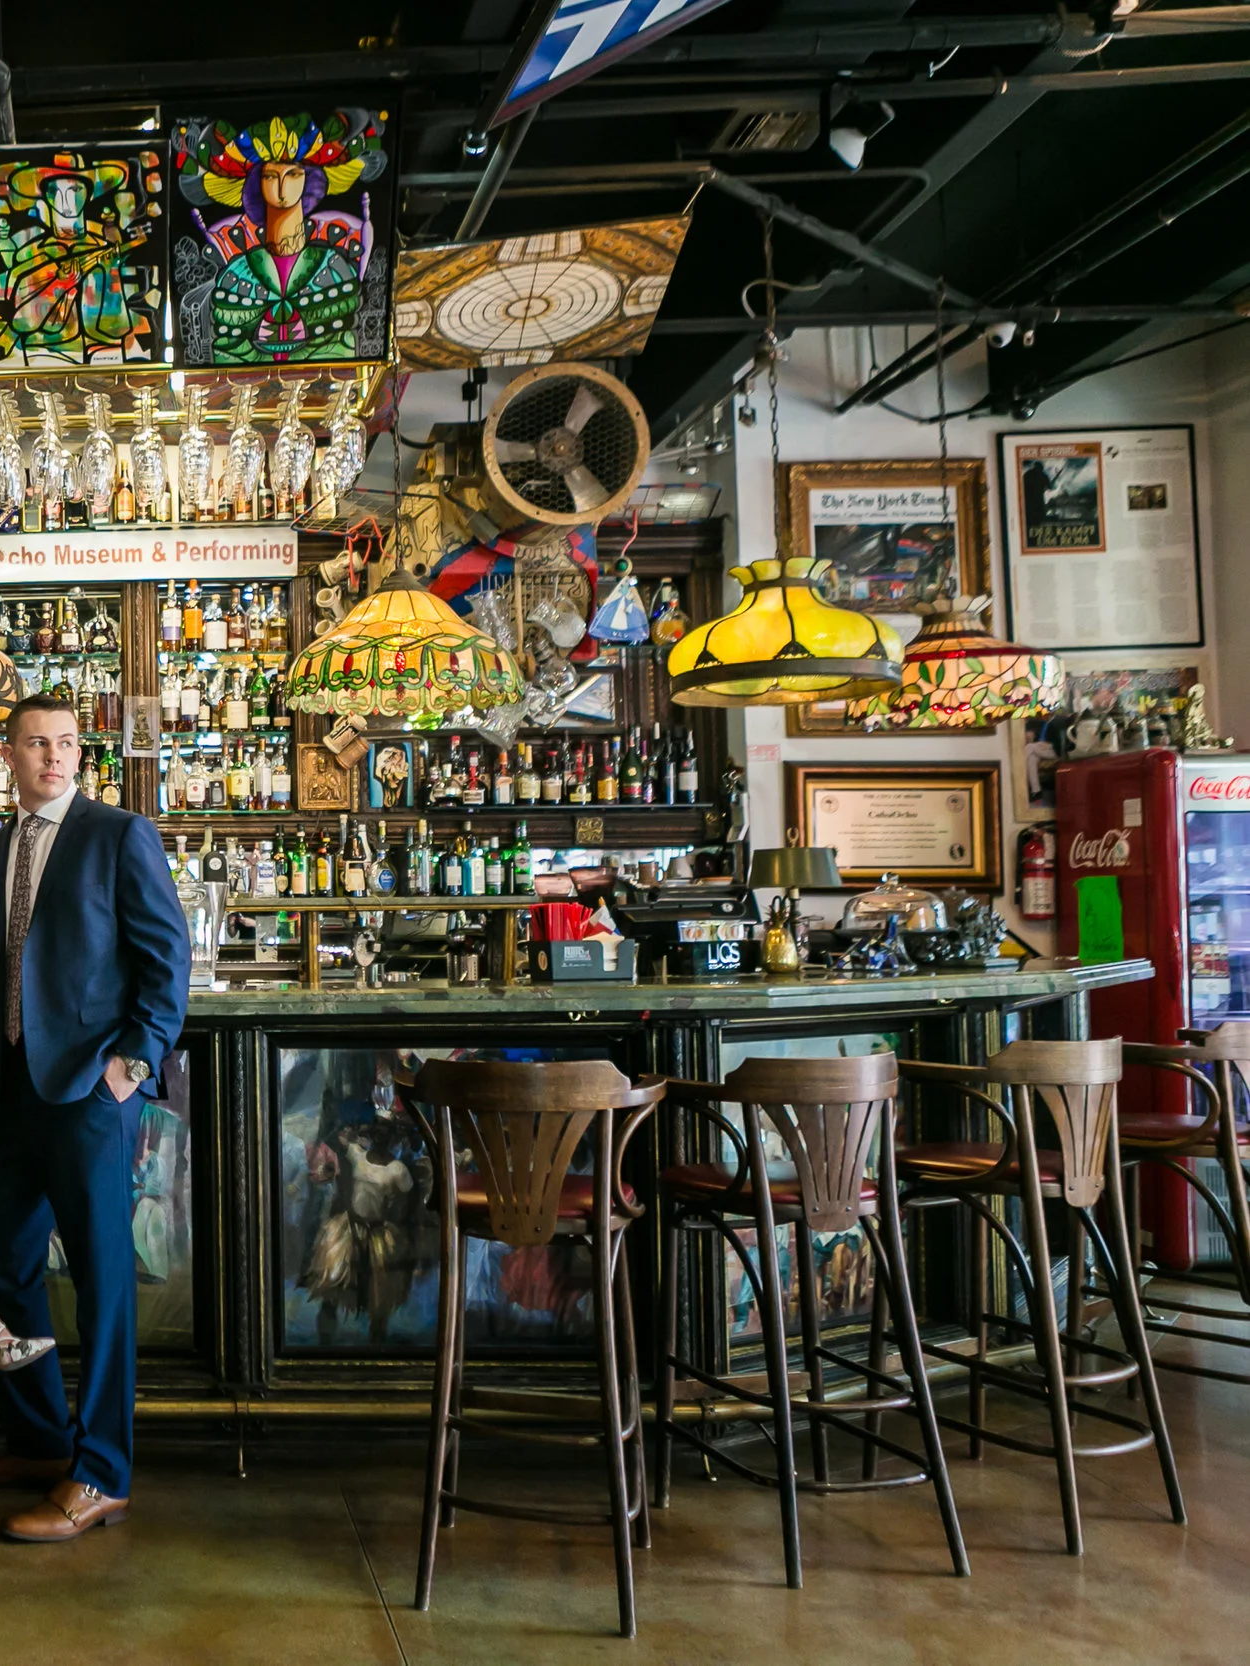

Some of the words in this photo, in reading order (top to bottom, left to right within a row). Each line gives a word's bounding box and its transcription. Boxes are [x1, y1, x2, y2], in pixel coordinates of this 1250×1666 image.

[821, 494, 844, 509] The
[847, 494, 874, 508] New
[877, 492, 909, 510] York
[54, 544, 143, 565] Museum
[151, 541, 167, 563] &
[175, 538, 294, 565] Performing
